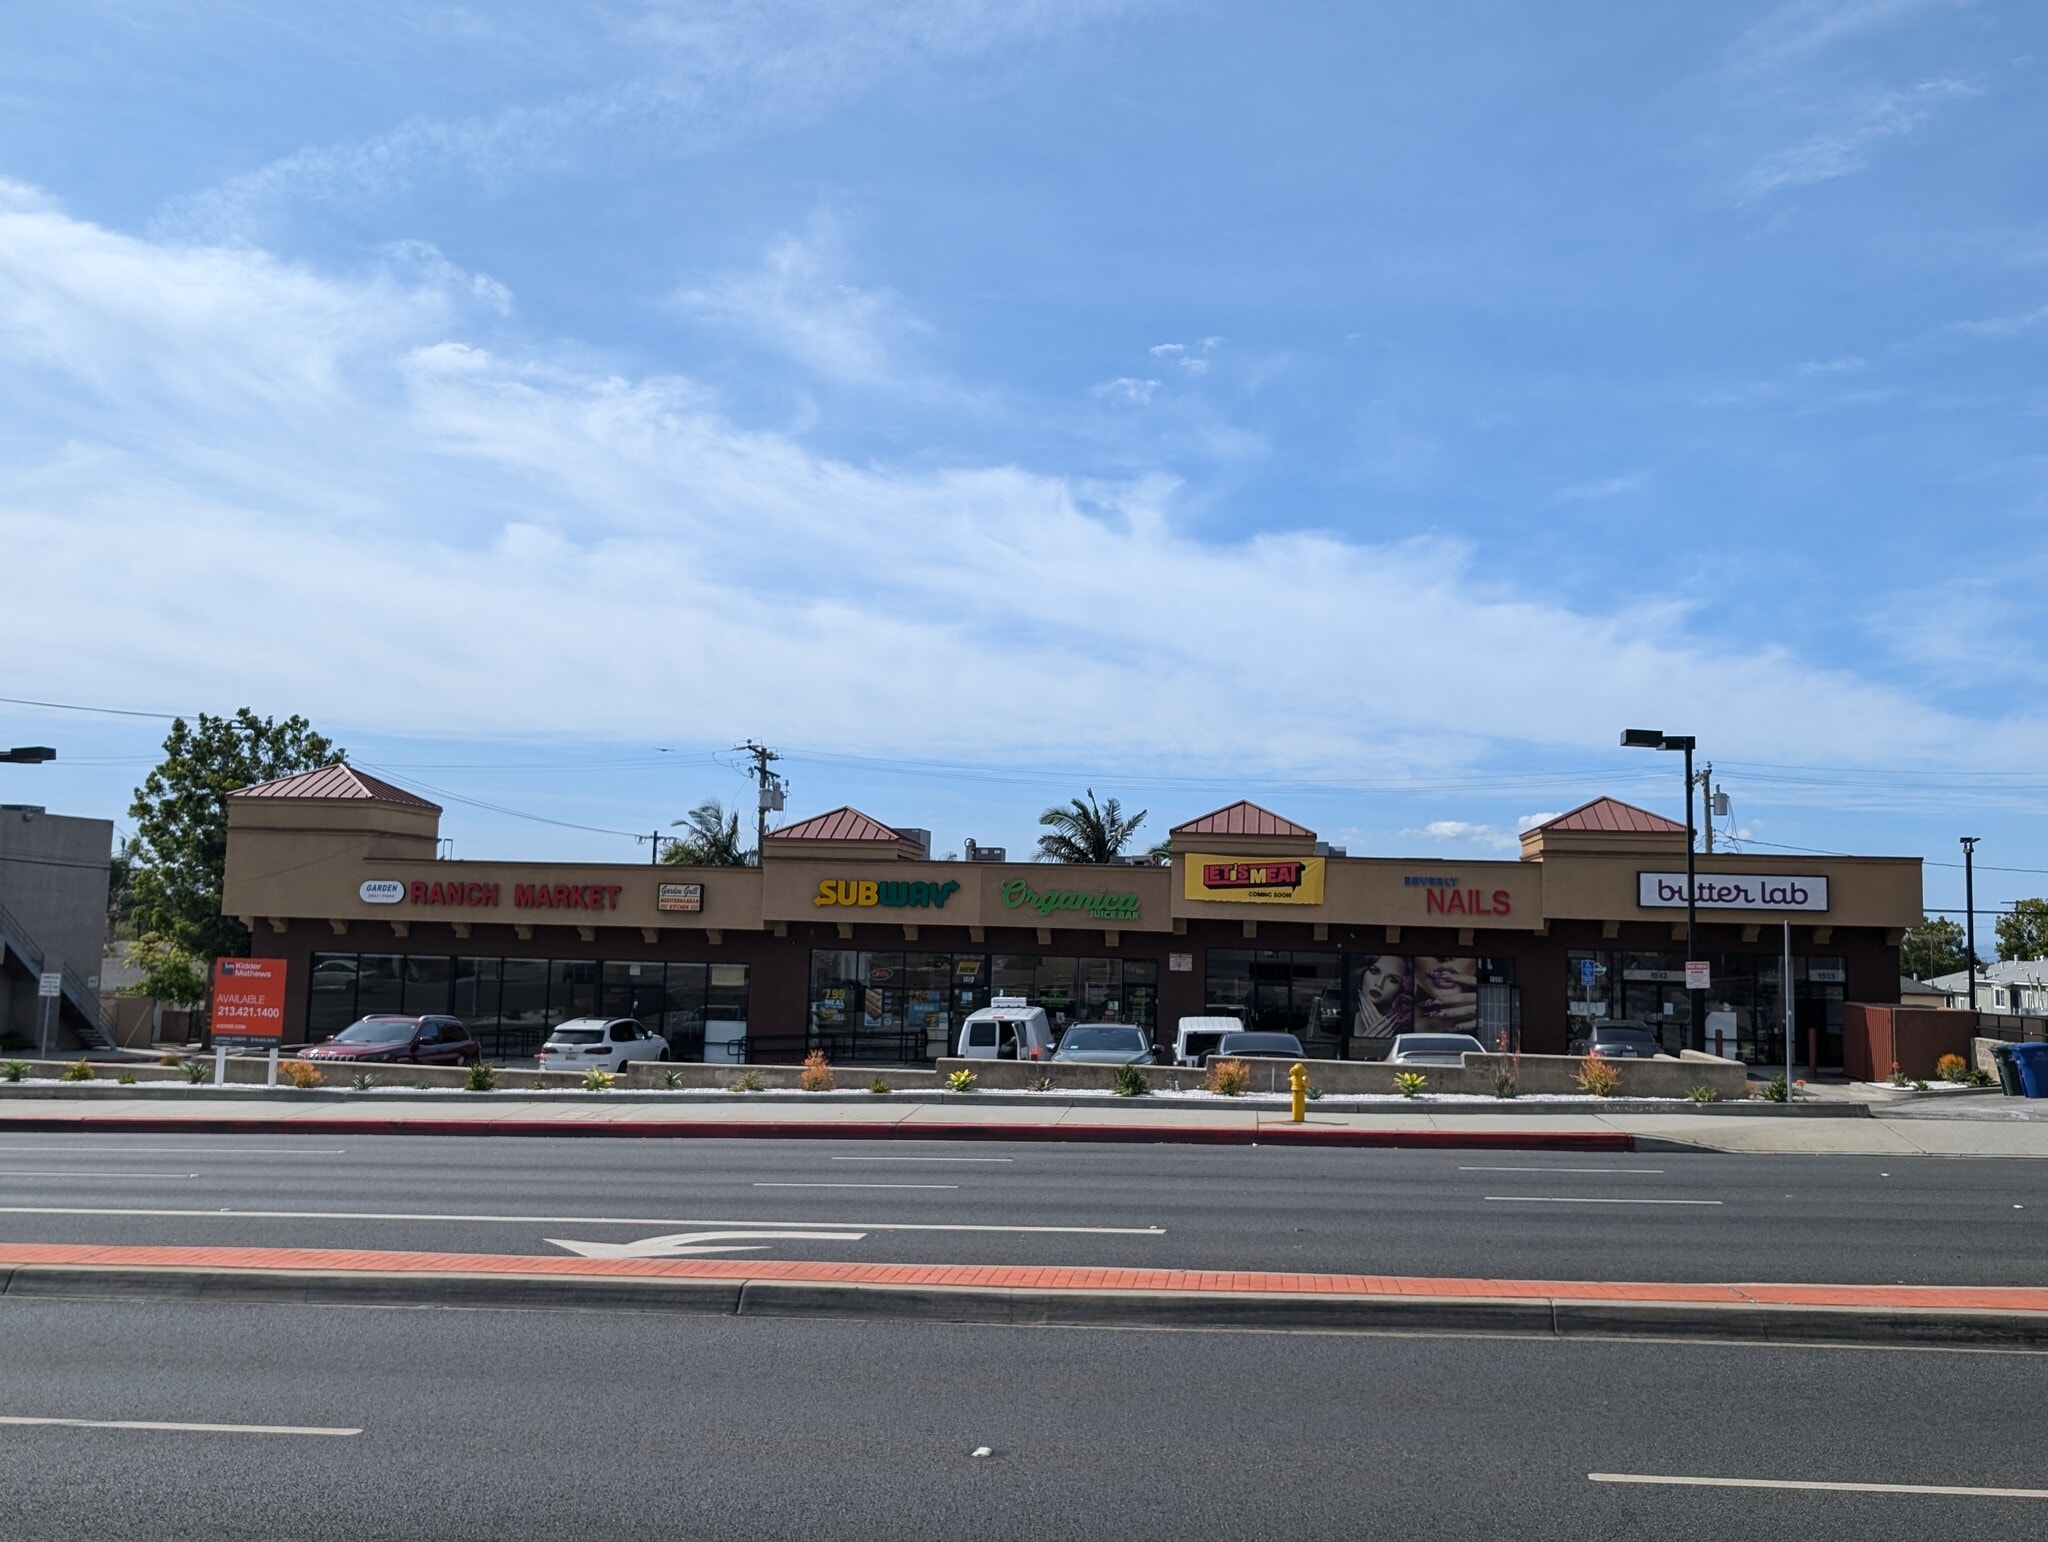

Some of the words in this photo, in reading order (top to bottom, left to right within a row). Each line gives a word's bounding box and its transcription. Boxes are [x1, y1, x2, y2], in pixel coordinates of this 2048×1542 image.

[1404, 876, 1457, 887] BEVERLY
[366, 884, 398, 892] GARDEN
[1761, 881, 1808, 905] lab
[411, 881, 499, 907] RANCH
[514, 883, 622, 910] MARKET
[813, 880, 960, 908] SUBWAY
[1000, 879, 1140, 916] Organica
[1426, 888, 1511, 915] NAILS
[1089, 909, 1115, 919] JUICE
[1118, 911, 1140, 920] BAR
[235, 962, 262, 970] Kidder
[235, 970, 272, 978] Mathews
[217, 994, 265, 1004] AVAILABLE
[218, 1006, 279, 1017] 213.421.1400
